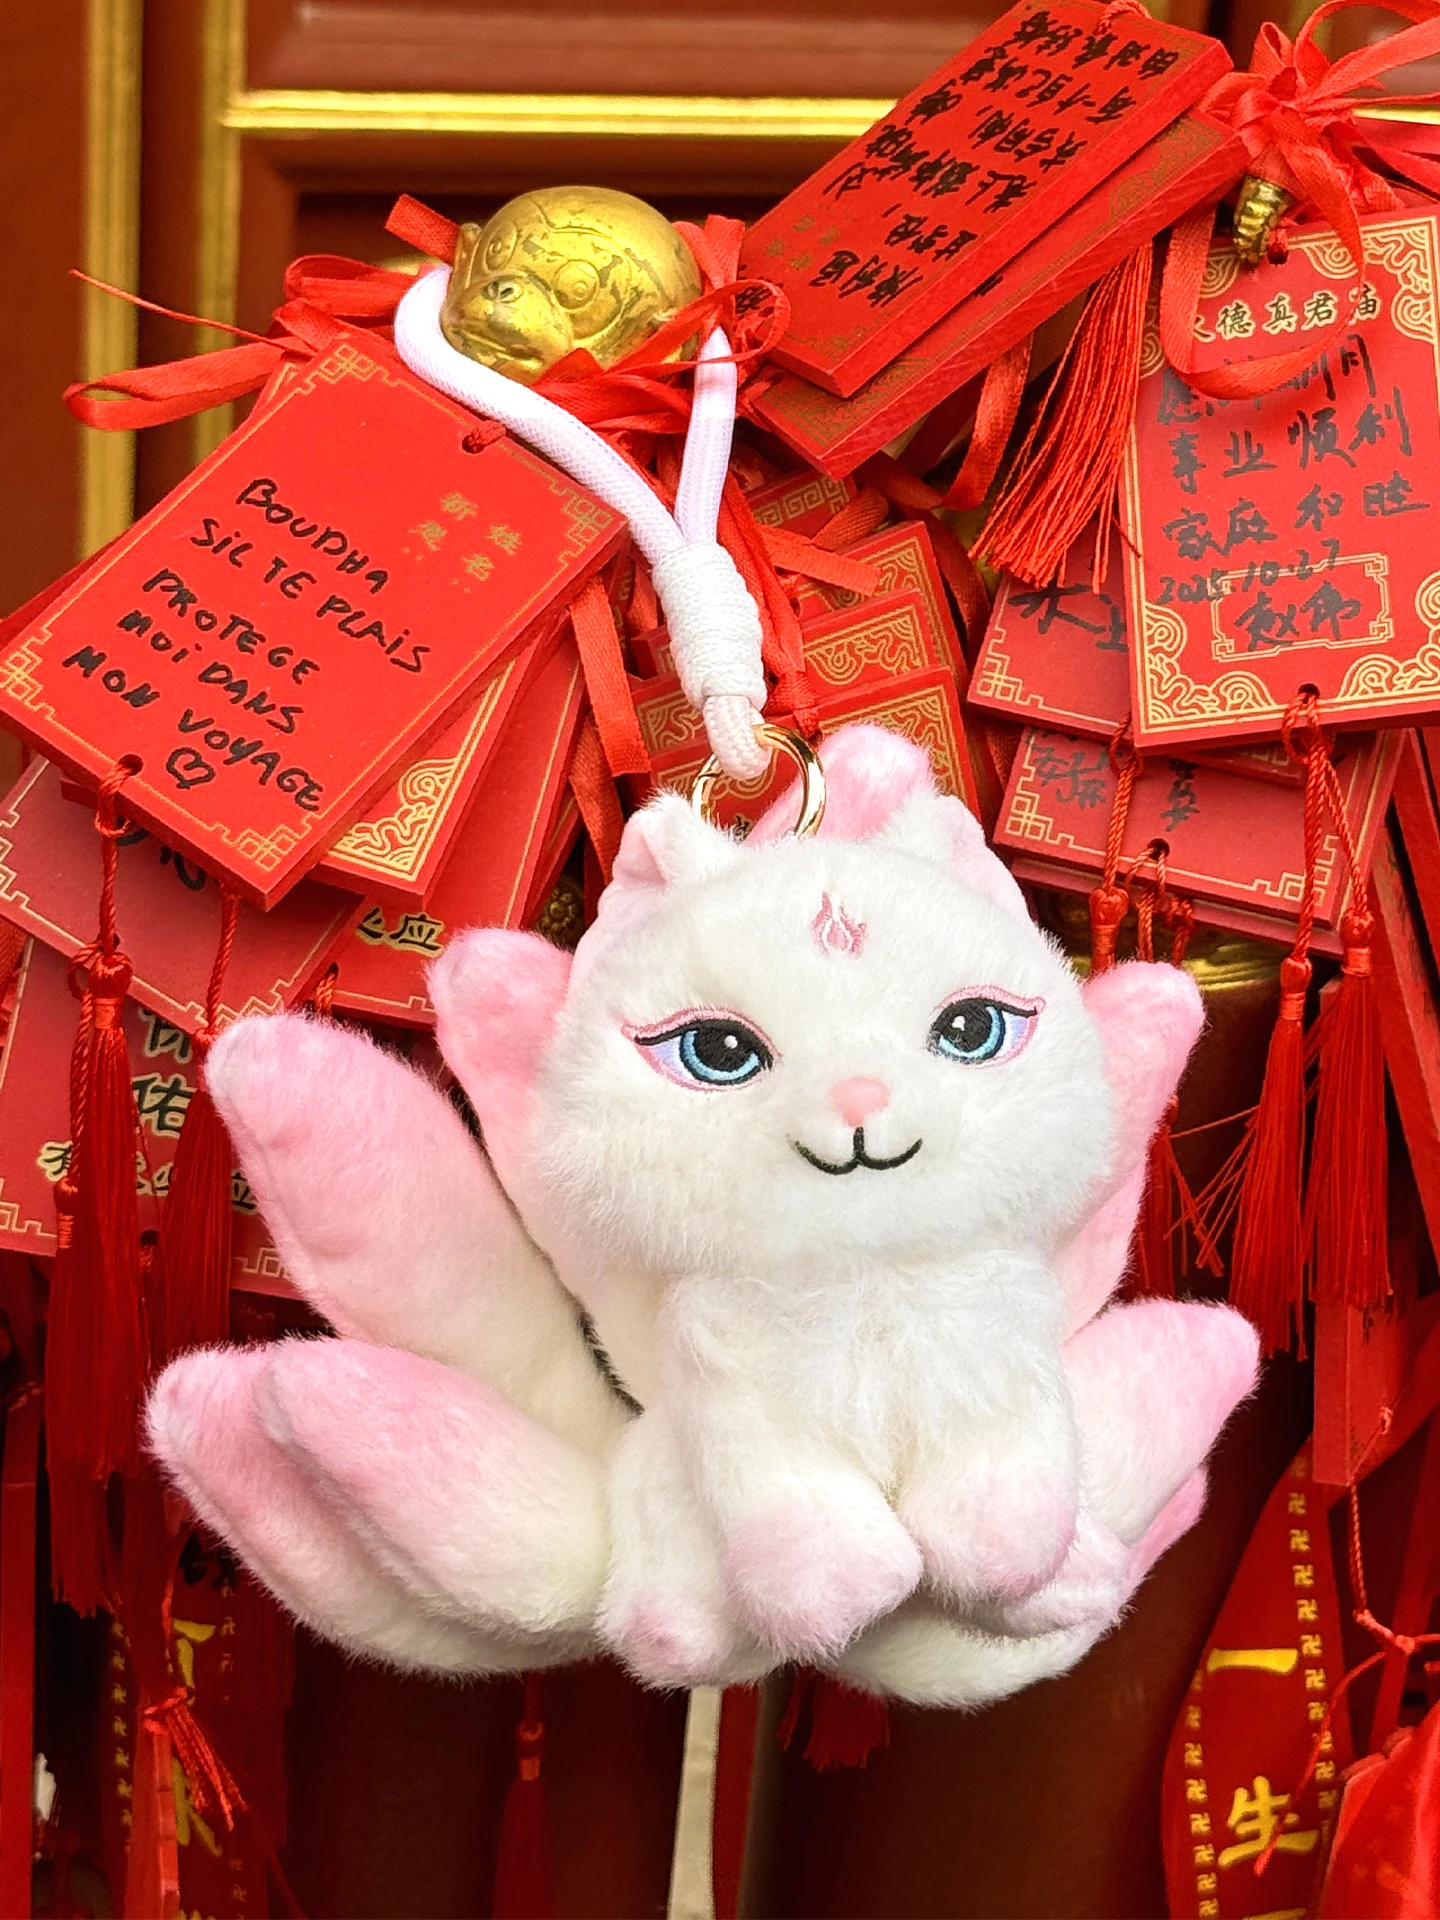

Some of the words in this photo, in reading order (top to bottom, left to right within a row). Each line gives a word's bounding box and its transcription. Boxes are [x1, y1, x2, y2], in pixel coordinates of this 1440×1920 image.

[263, 555, 319, 600] TE
[141, 567, 322, 686] PROTEGE
[60, 644, 161, 709] MON
[176, 707, 324, 813] VOYAGE
[197, 660, 305, 735] DANS
